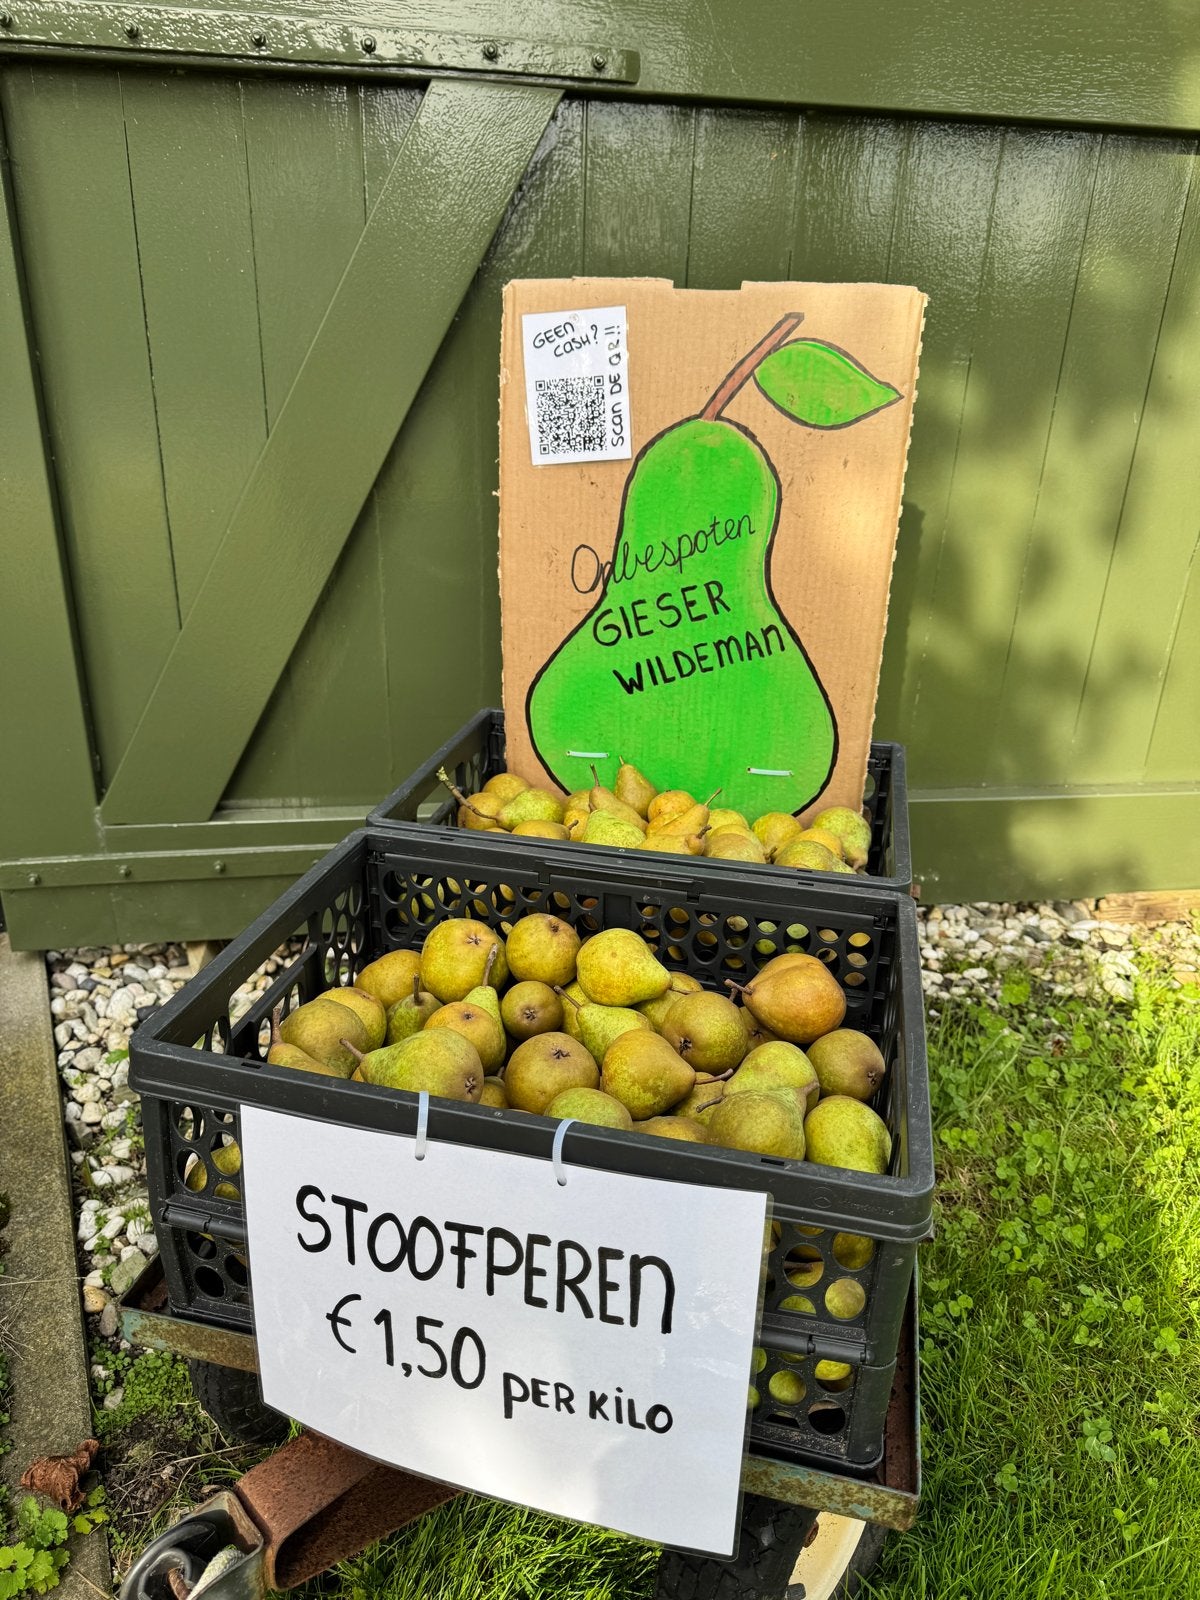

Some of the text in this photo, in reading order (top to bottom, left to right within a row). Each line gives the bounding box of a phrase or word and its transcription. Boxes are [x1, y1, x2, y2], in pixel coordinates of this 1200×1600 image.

[532, 321, 576, 349] GEEN
[608, 373, 622, 396] DE
[592, 580, 732, 647] GIESER
[612, 624, 786, 695] WILDEMAN
[295, 1184, 676, 1335] STOOFPEREN
[502, 1371, 577, 1420] PER
